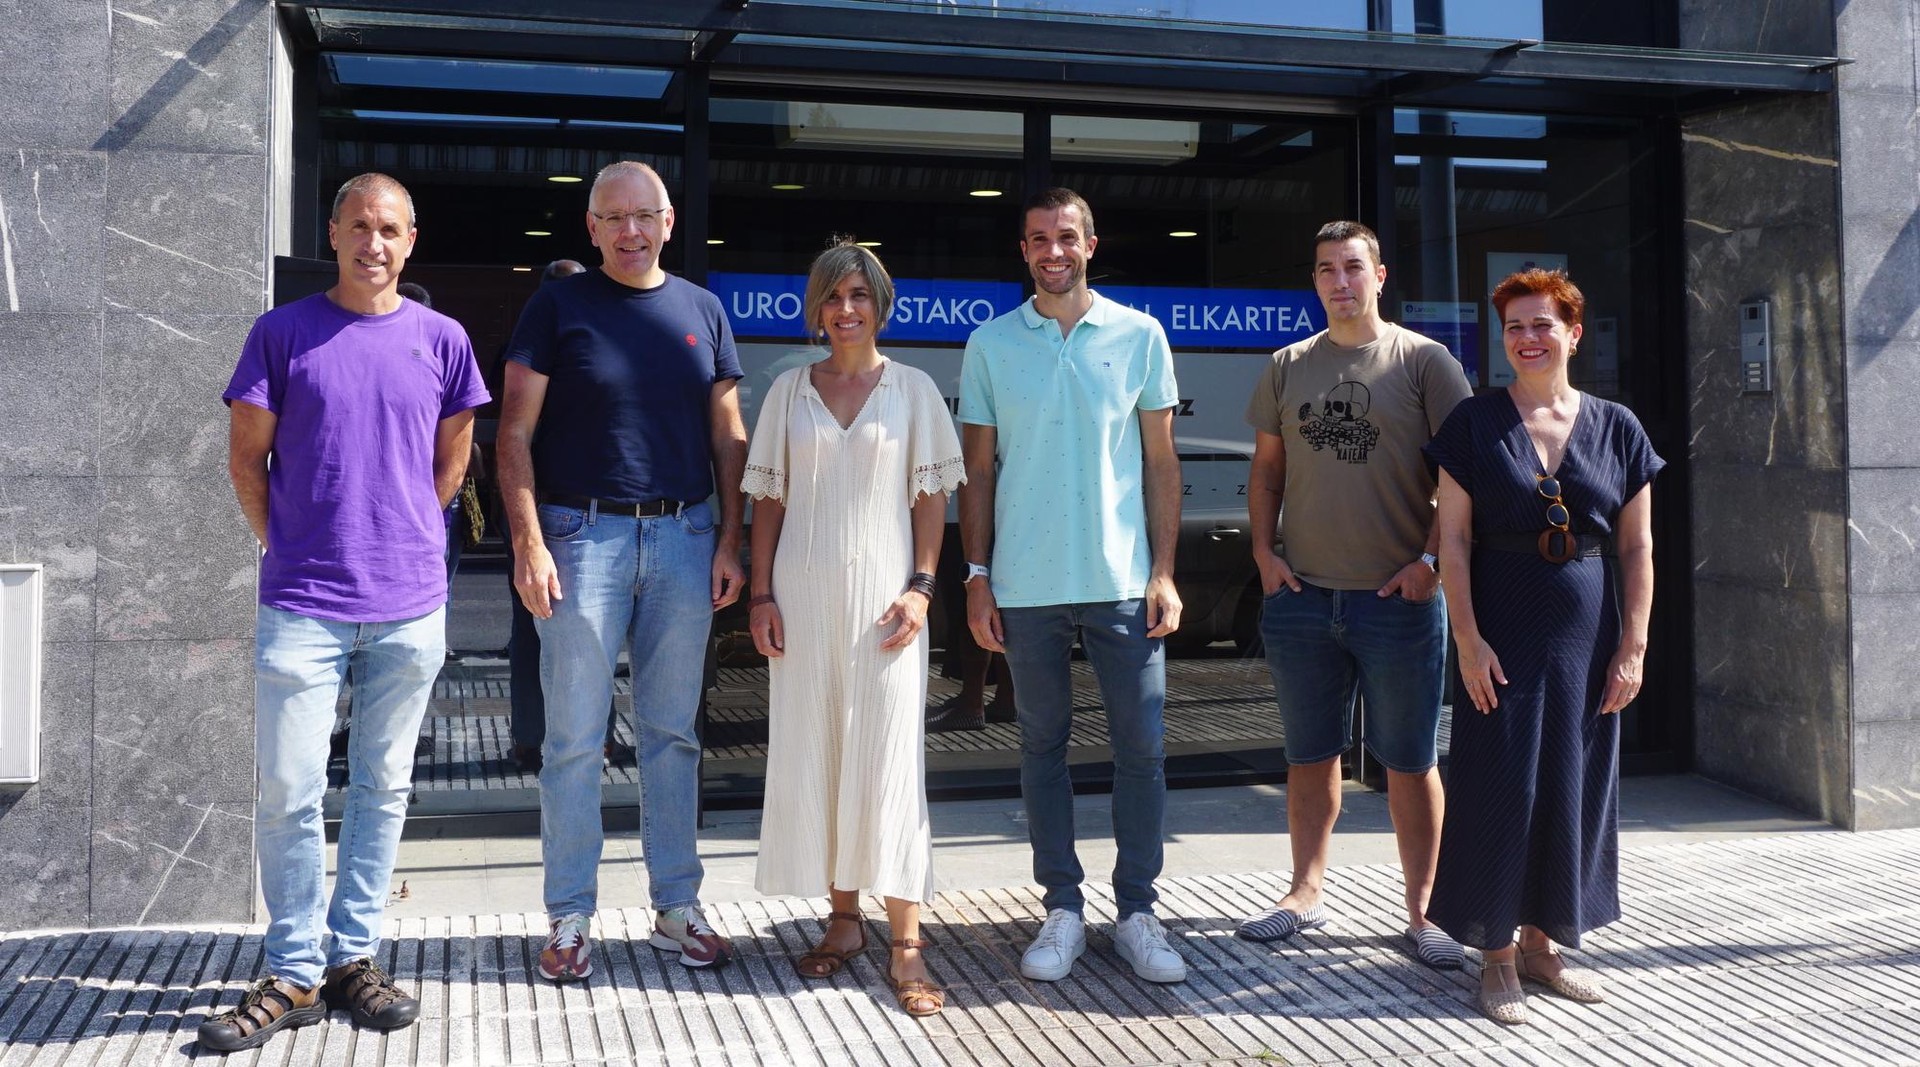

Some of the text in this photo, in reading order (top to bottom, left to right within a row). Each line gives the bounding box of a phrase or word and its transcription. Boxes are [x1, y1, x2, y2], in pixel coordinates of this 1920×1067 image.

[733, 291, 807, 320] URO
[887, 296, 994, 326] STAKO
[1172, 304, 1314, 332] ELKARTEA
